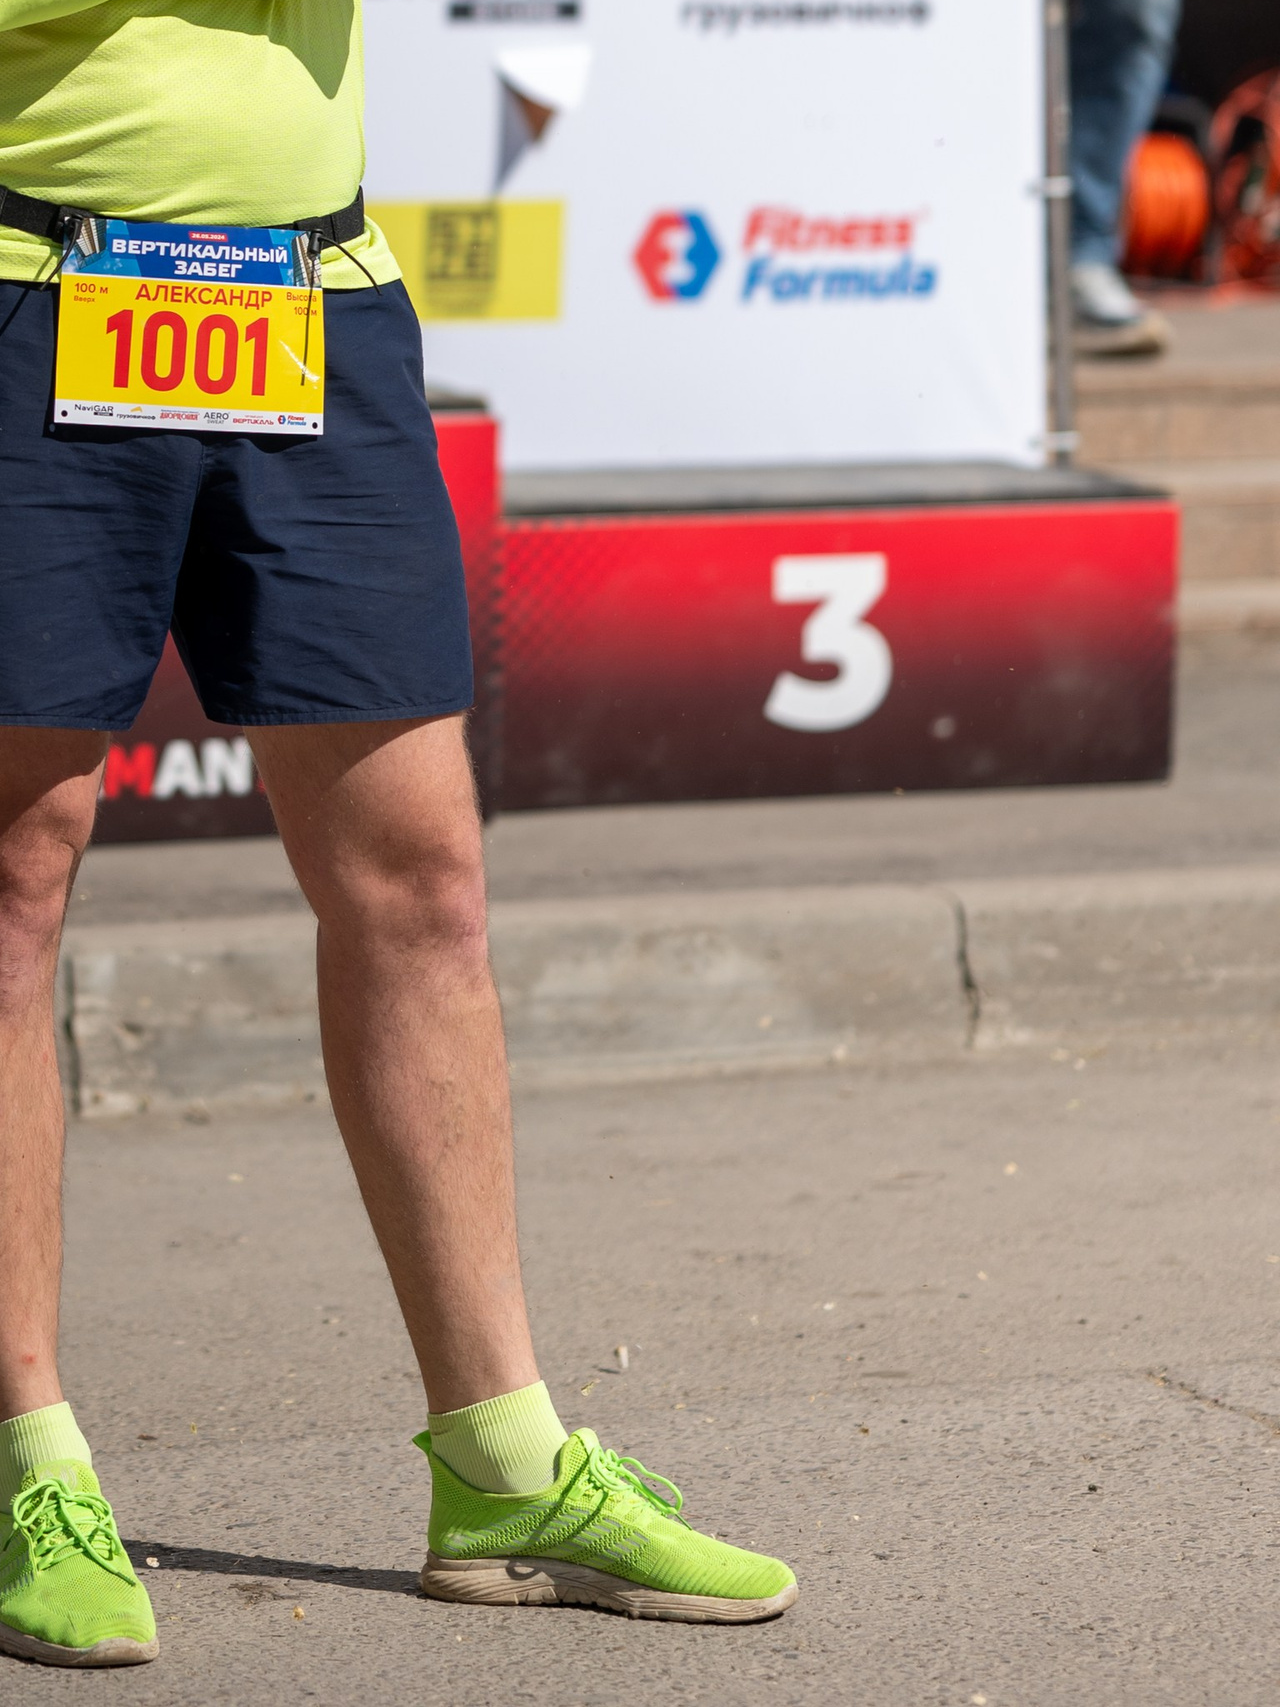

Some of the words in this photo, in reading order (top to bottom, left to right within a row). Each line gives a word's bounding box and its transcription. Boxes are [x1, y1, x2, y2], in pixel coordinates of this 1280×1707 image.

[738, 204, 918, 254] Fitness
[111, 238, 288, 264] ВЕРТИКАЛЬНЫЙ
[173, 260, 243, 278] ЗАБЕГ
[738, 253, 938, 304] Formula
[73, 295, 97, 304] Вверх
[74, 283, 97, 294] 100
[134, 283, 273, 311] АЛЕКСАНДР
[286, 291, 318, 303] Высоа
[105, 308, 269, 396] 1001
[74, 404, 114, 413] NaviGAR
[203, 411, 230, 421] AERO
[764, 552, 894, 730] 3
